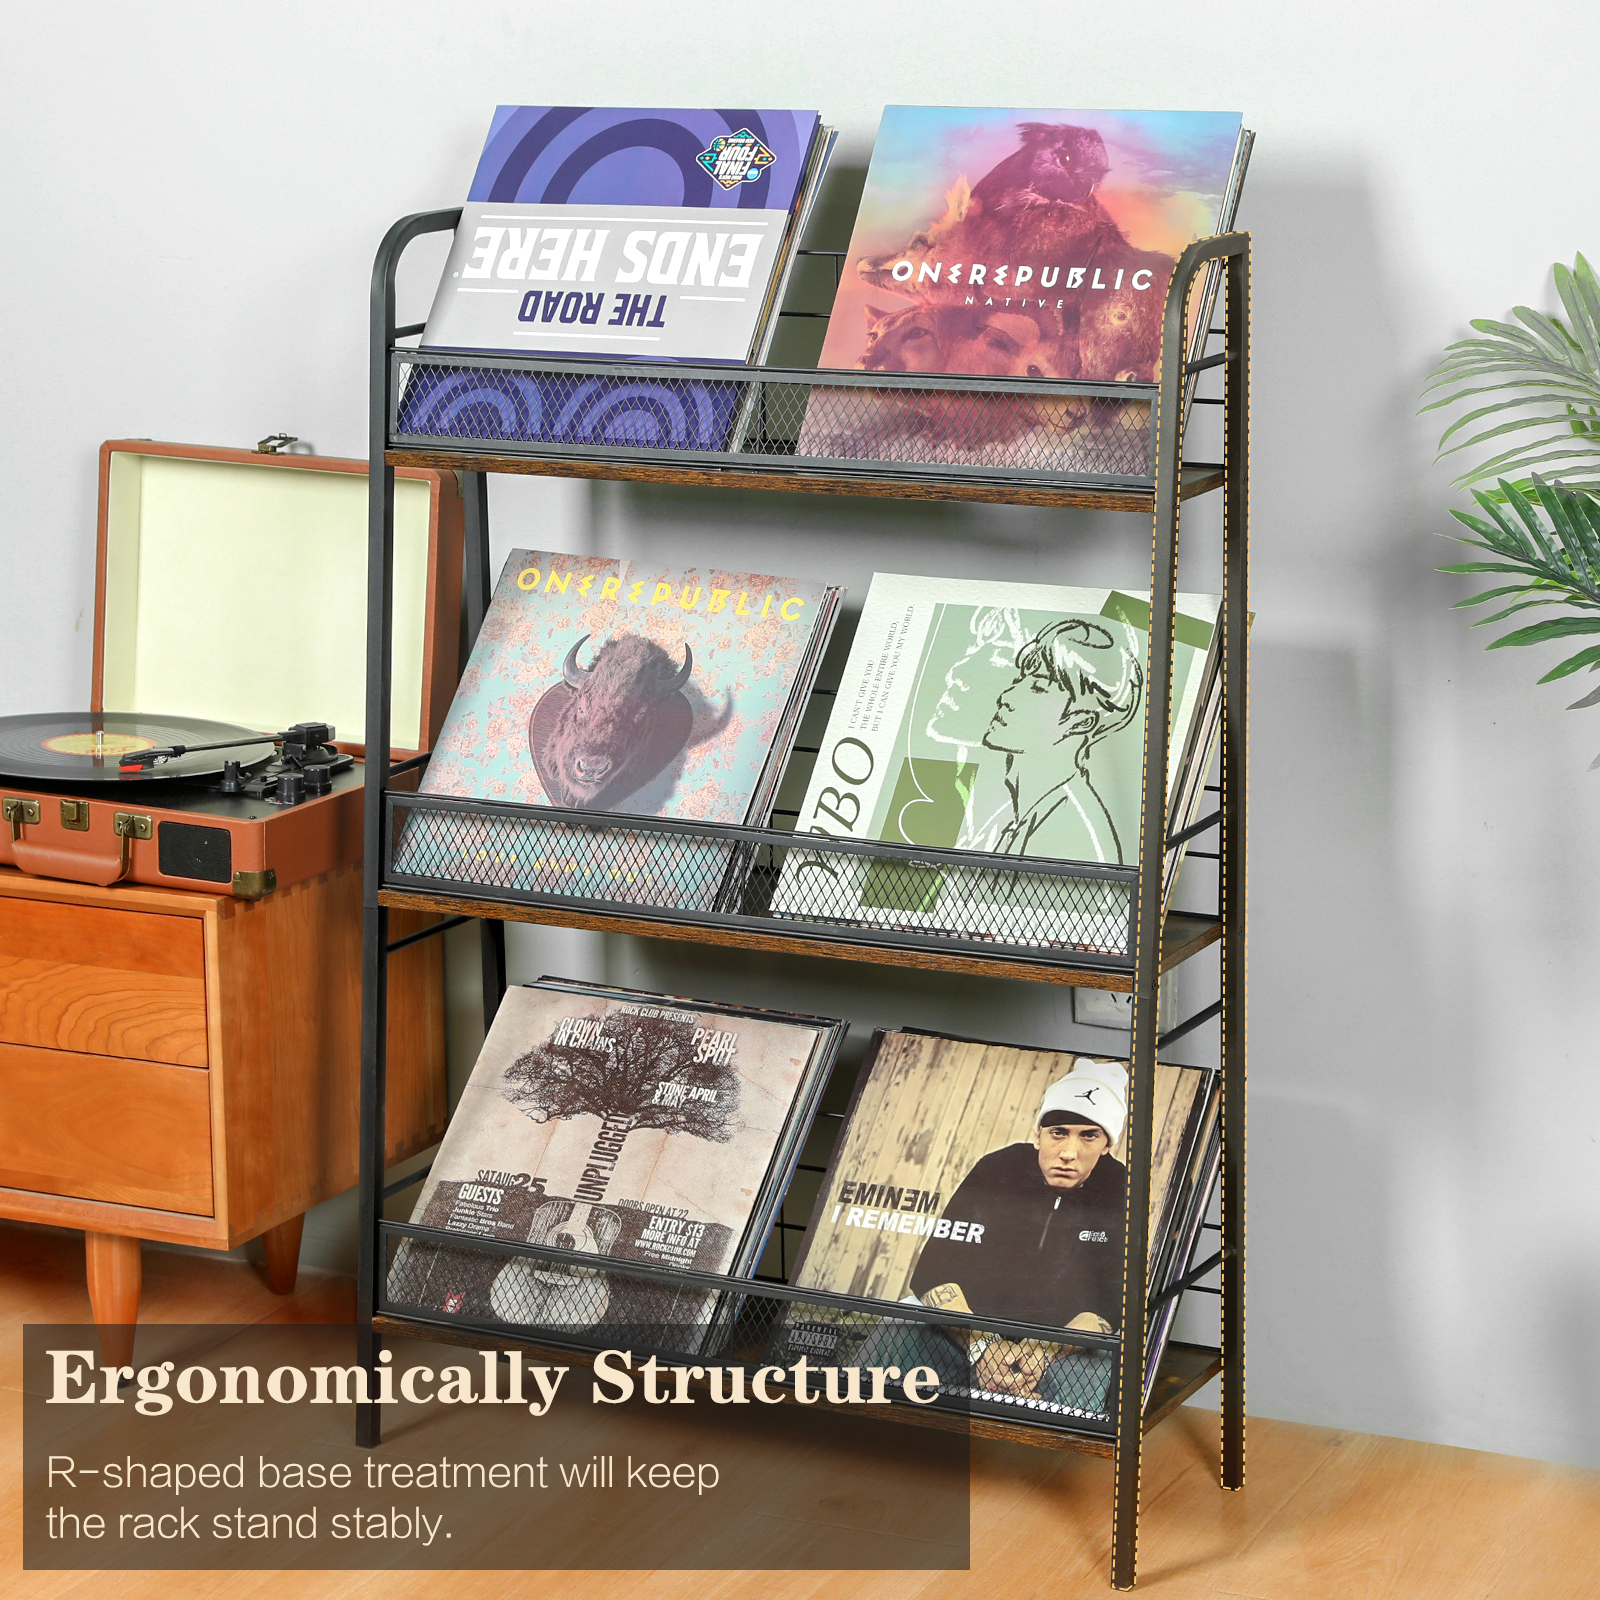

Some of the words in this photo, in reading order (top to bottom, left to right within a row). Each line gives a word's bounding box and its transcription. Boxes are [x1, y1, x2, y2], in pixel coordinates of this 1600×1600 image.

[718, 146, 758, 161] FOUR
[713, 160, 752, 176] FINAL
[461, 226, 611, 282] HERE
[614, 230, 765, 288] ENDS
[891, 260, 1154, 291] ONEREPUBLIC
[517, 290, 606, 324] ROAD
[607, 293, 668, 328] THE
[965, 296, 1064, 309] NATIVE
[517, 567, 805, 621] ONEREPUBLIC
[896, 636, 906, 650] MY
[875, 652, 889, 682] ENTIRE
[890, 651, 902, 669] YOU
[858, 679, 870, 698] GIVE
[864, 660, 875, 678] YOU
[884, 670, 896, 690] GIVE
[865, 683, 880, 713] WHOLE
[879, 692, 890, 712] CAN
[860, 714, 871, 730] THE
[871, 716, 882, 732] BUT
[796, 736, 874, 884] YBO
[620, 1005, 640, 1016] ROCK
[640, 1008, 660, 1019] CLUB
[660, 1010, 696, 1024] PRESENTS
[560, 1017, 604, 1034] CLOWN
[554, 1031, 570, 1046] IN
[570, 1033, 617, 1053] CHAINS
[691, 1028, 740, 1049] PEARL
[693, 1045, 736, 1067] SPOT
[656, 1082, 689, 1098] STONE
[688, 1086, 718, 1103] APRIL
[661, 1093, 686, 1108] MAY
[574, 1113, 632, 1202] UNPLUGGED
[458, 1183, 504, 1205] GUESTS
[838, 1180, 941, 1215] EMINEM
[452, 1207, 476, 1216] Junkie
[486, 1205, 500, 1213] Trio
[618, 1198, 644, 1212] DOORS
[644, 1203, 666, 1216] OPEN
[665, 1207, 678, 1218] AT
[678, 1209, 689, 1219] 22
[479, 1219, 496, 1227] Bros
[497, 1221, 515, 1230] Band
[648, 1216, 686, 1234] ENTRY
[685, 1223, 705, 1238] $13
[830, 1205, 842, 1224] I
[845, 1206, 985, 1244] REMEMBER
[634, 1239, 697, 1258] WWW.ROCKCLUB.COM
[641, 1228, 667, 1243] MORE
[666, 1233, 688, 1246] INFO
[687, 1237, 702, 1249] AT
[644, 1250, 660, 1259] Free
[661, 1254, 692, 1264] Midnight
